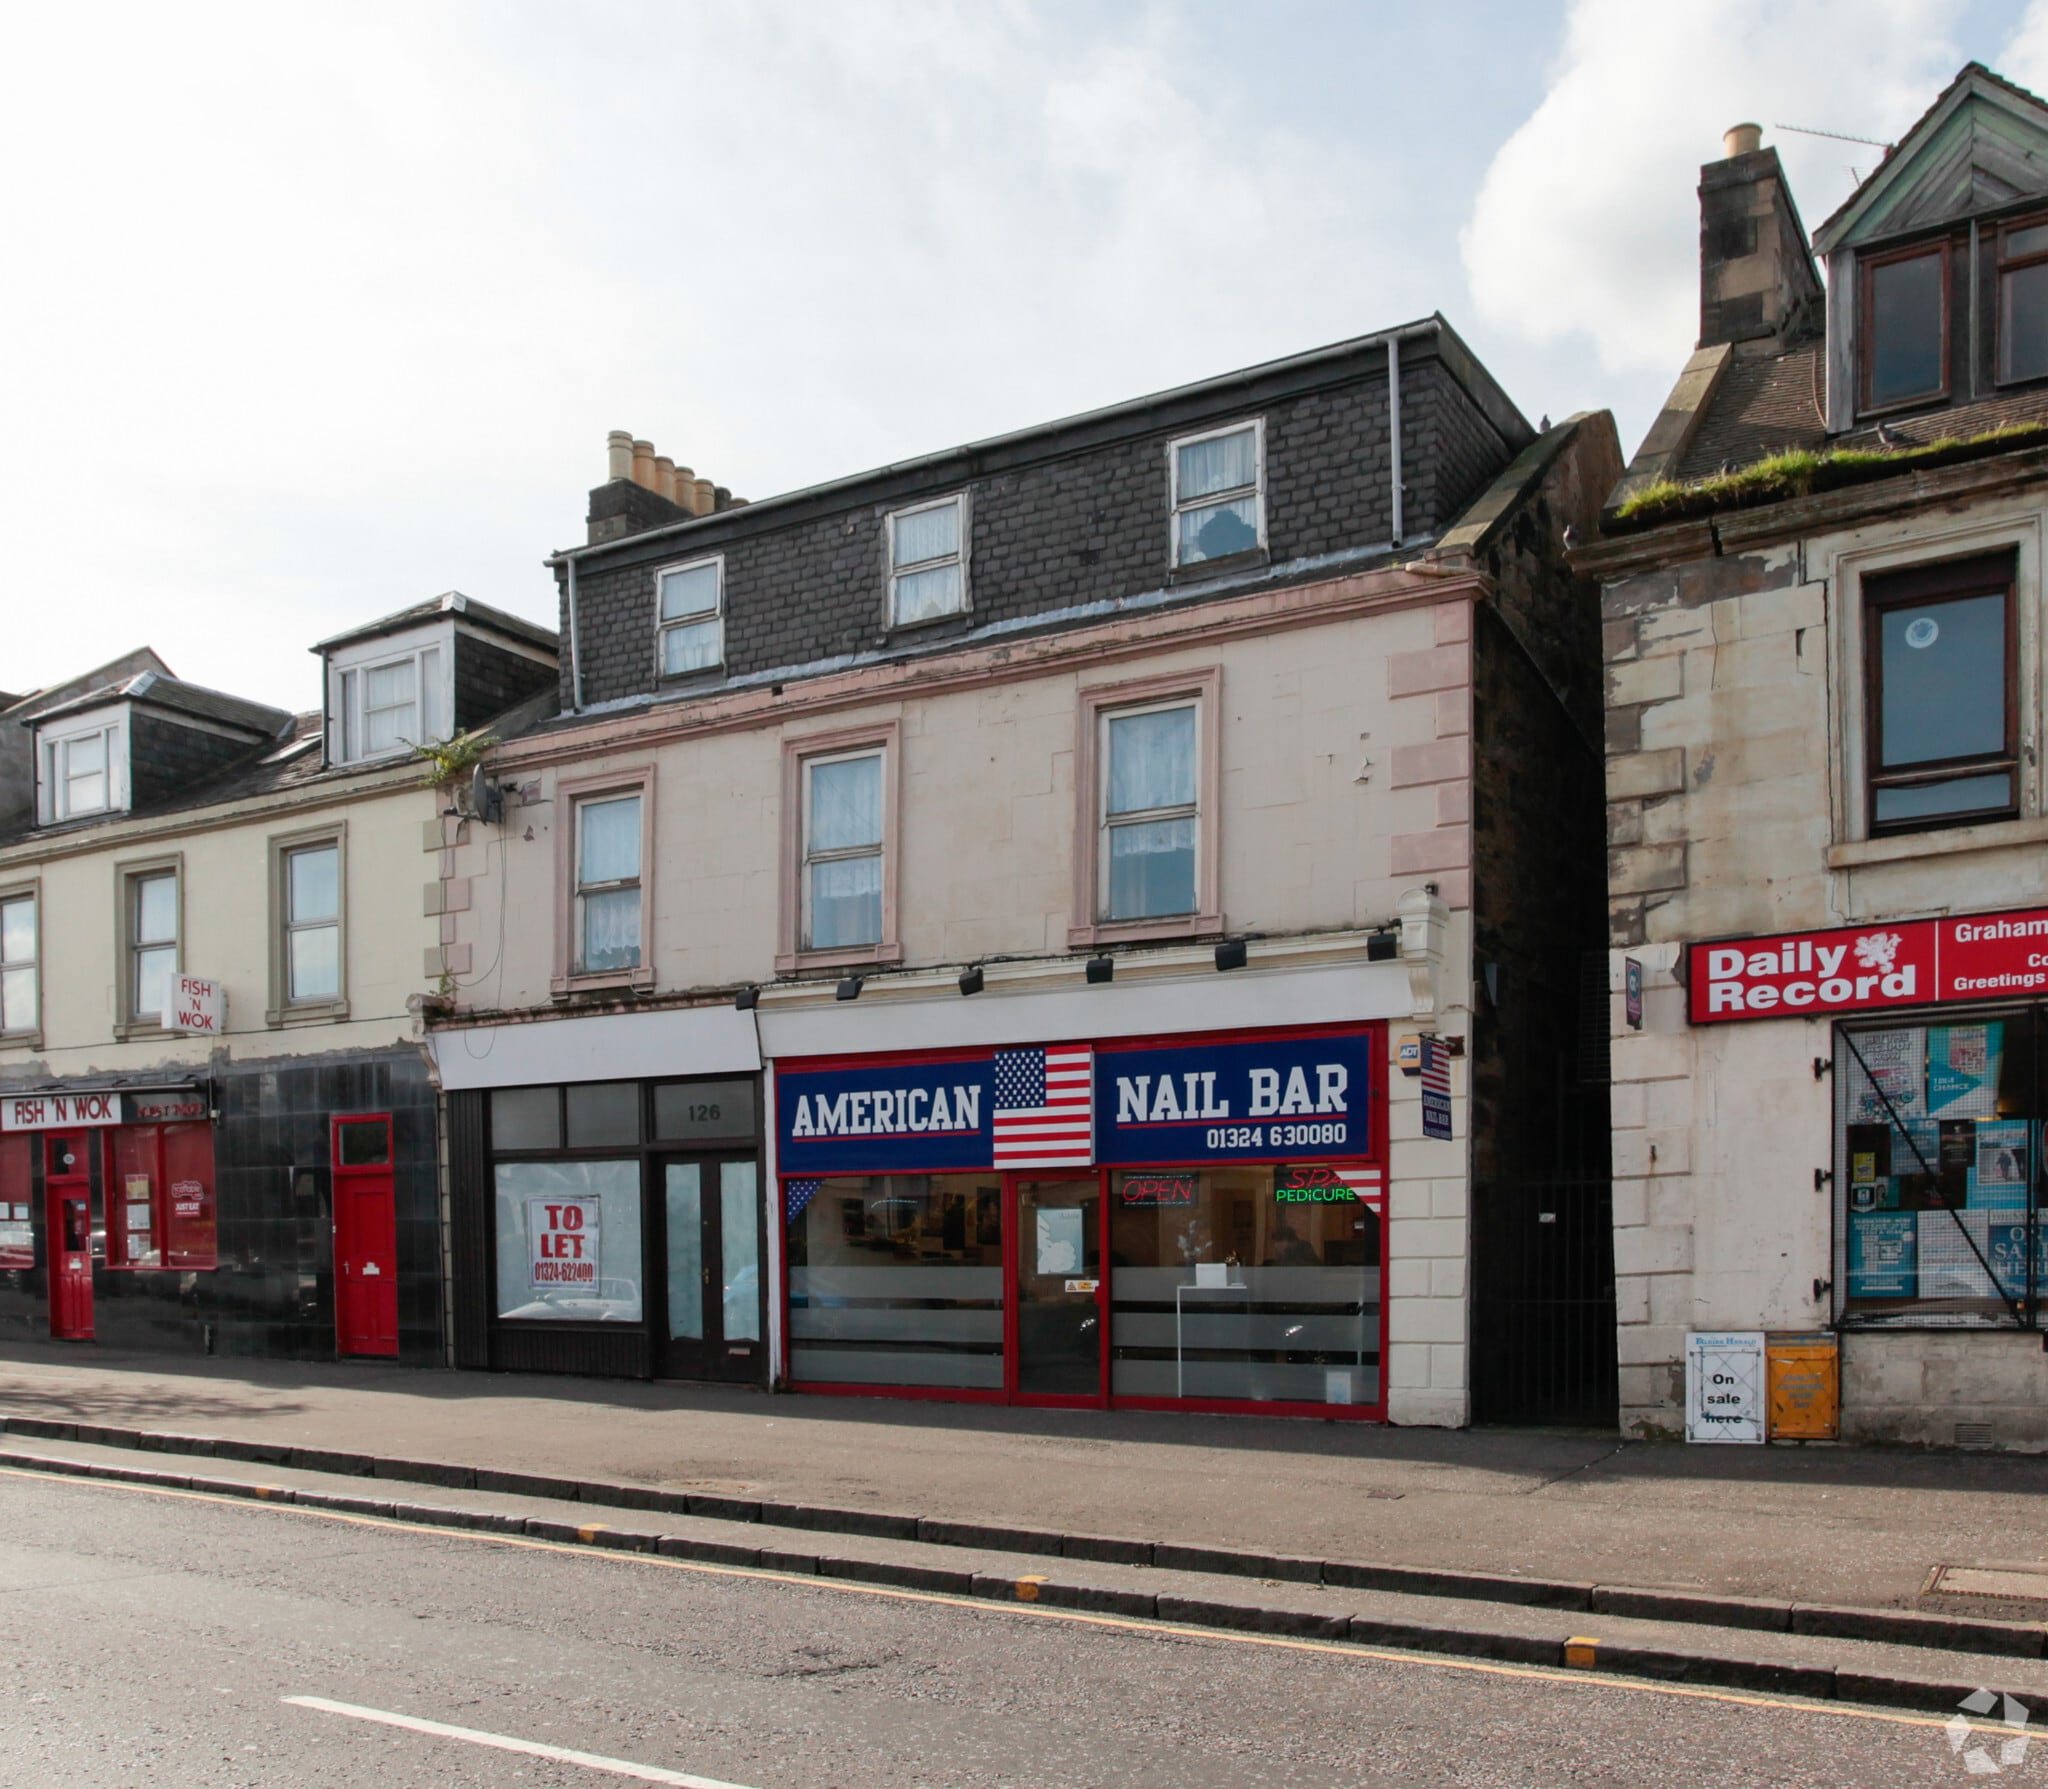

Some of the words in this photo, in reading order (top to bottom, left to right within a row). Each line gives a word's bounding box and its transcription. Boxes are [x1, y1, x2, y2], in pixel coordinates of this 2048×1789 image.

[1708, 941, 1848, 980] Daily
[181, 978, 211, 998] FISH
[1708, 965, 1916, 1013] Record
[1954, 973, 2046, 991] Greetings
[179, 1010, 213, 1030] WOK
[1400, 1047, 1418, 1057] ADT
[1116, 1071, 1230, 1124] NAIL
[1249, 1064, 1348, 1117] BAR
[15, 1101, 44, 1124] FISH
[74, 1095, 112, 1119] WOK
[688, 1104, 721, 1121] 126
[792, 1085, 981, 1137] AMERICAN
[1206, 1127, 1263, 1150] 01324
[1269, 1124, 1347, 1147] 630080
[1122, 1179, 1193, 1201] OPEN
[544, 1205, 583, 1231] TO
[541, 1233, 585, 1258] LET
[535, 1262, 593, 1282] 01324-622400
[1712, 1374, 1734, 1385] On
[1707, 1394, 1741, 1404] sale
[1704, 1411, 1744, 1424] here
